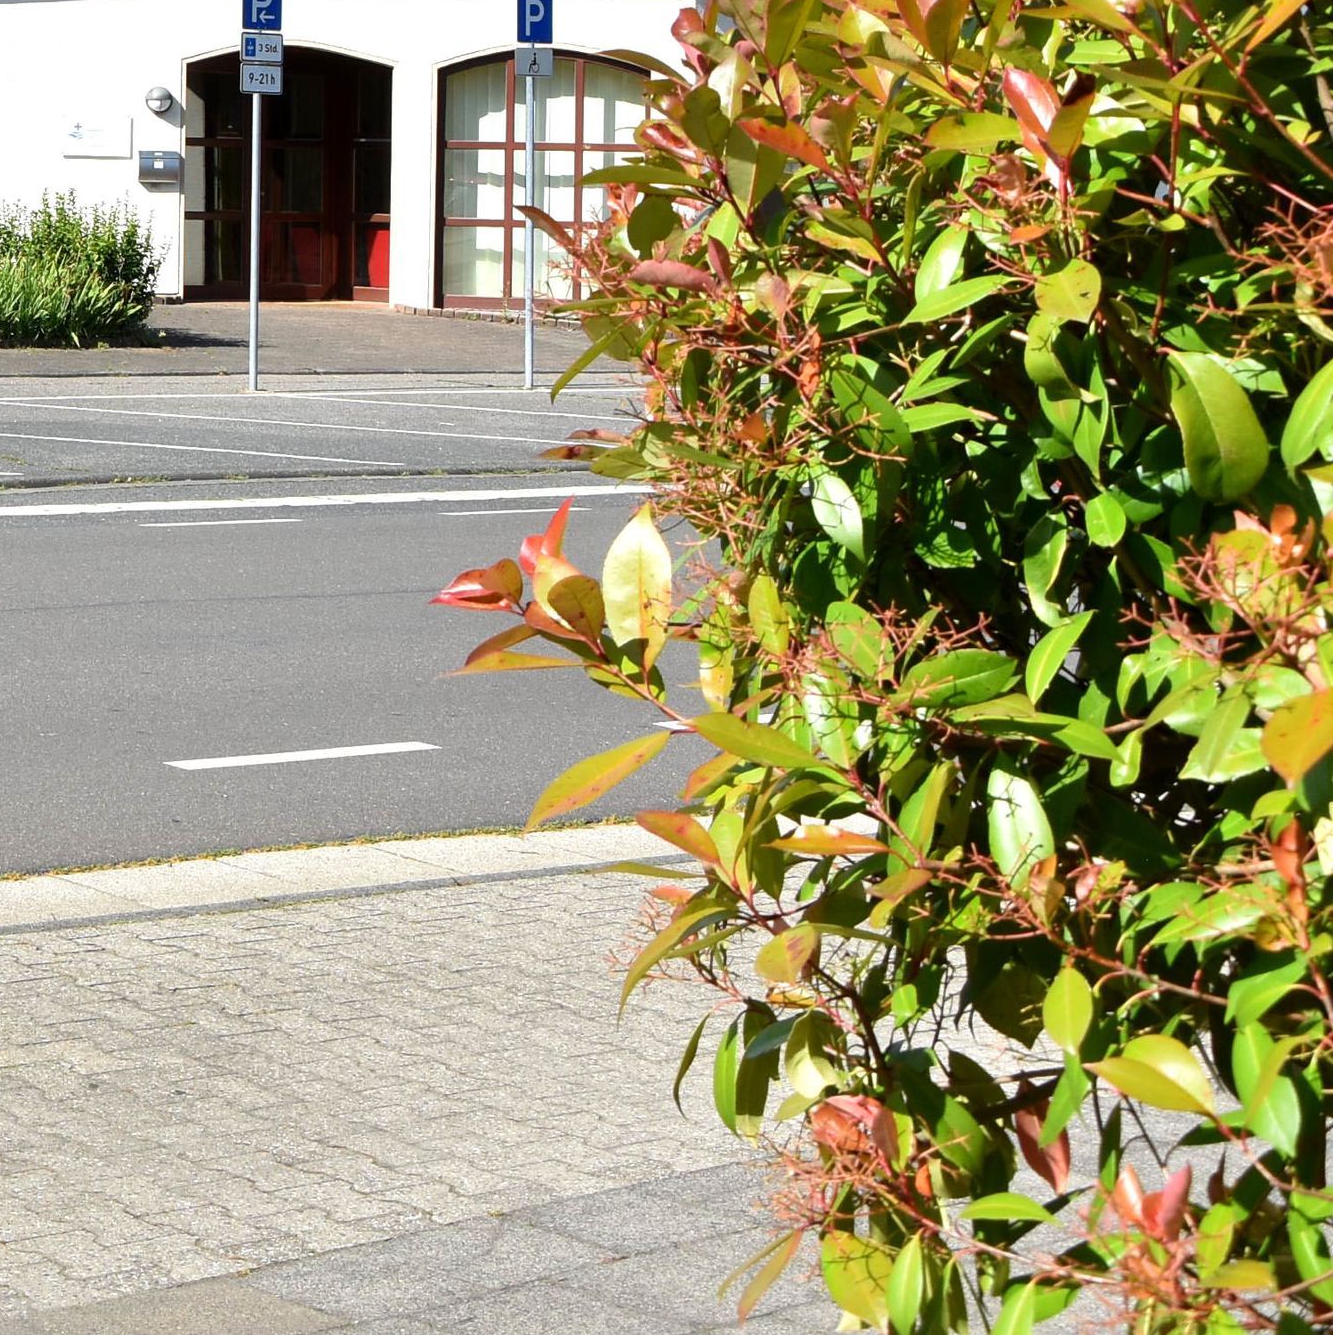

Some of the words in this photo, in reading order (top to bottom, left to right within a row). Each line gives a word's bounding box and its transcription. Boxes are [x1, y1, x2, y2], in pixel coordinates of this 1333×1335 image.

[258, 43, 264, 53] 3
[248, 72, 269, 85] 9-21
[270, 74, 276, 86] h
